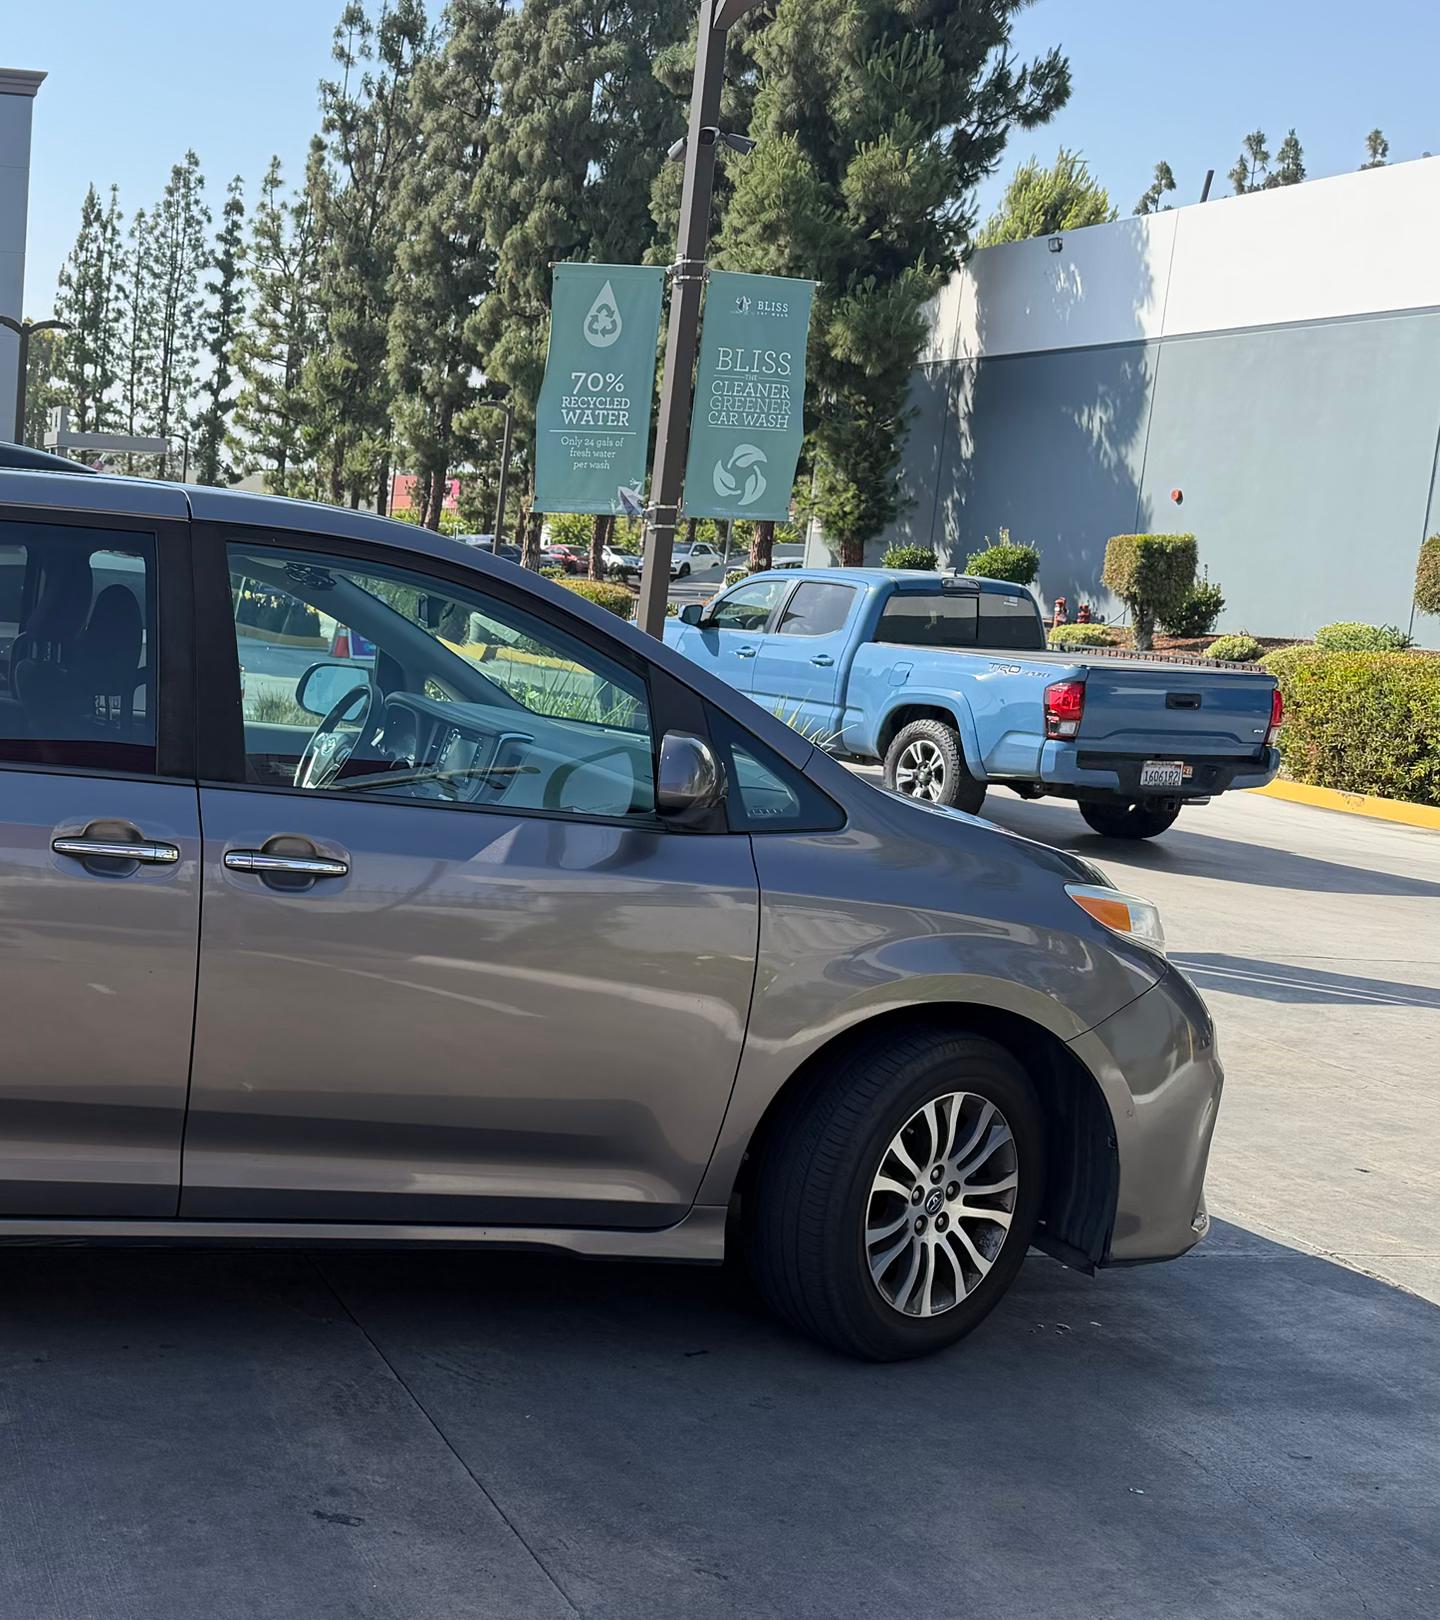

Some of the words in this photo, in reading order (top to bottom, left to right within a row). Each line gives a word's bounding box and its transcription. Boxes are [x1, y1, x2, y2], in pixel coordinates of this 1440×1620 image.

[757, 301, 788, 312] BLISS
[715, 347, 791, 376] BLISS
[571, 372, 624, 394] 70%
[711, 380, 790, 399] CLEANER
[561, 396, 630, 408] RECYCLED
[709, 395, 791, 414] GREENER
[561, 409, 629, 426] WATER
[708, 411, 738, 425] CAR
[742, 412, 789, 428] WASH
[561, 435, 582, 447] Only
[584, 438, 595, 446] 24
[596, 437, 614, 448] gals
[615, 437, 624, 447] of
[569, 447, 591, 457] fresh
[592, 450, 616, 458] water
[573, 461, 588, 470] per
[589, 460, 610, 470] wash
[988, 662, 1022, 675] TRD
